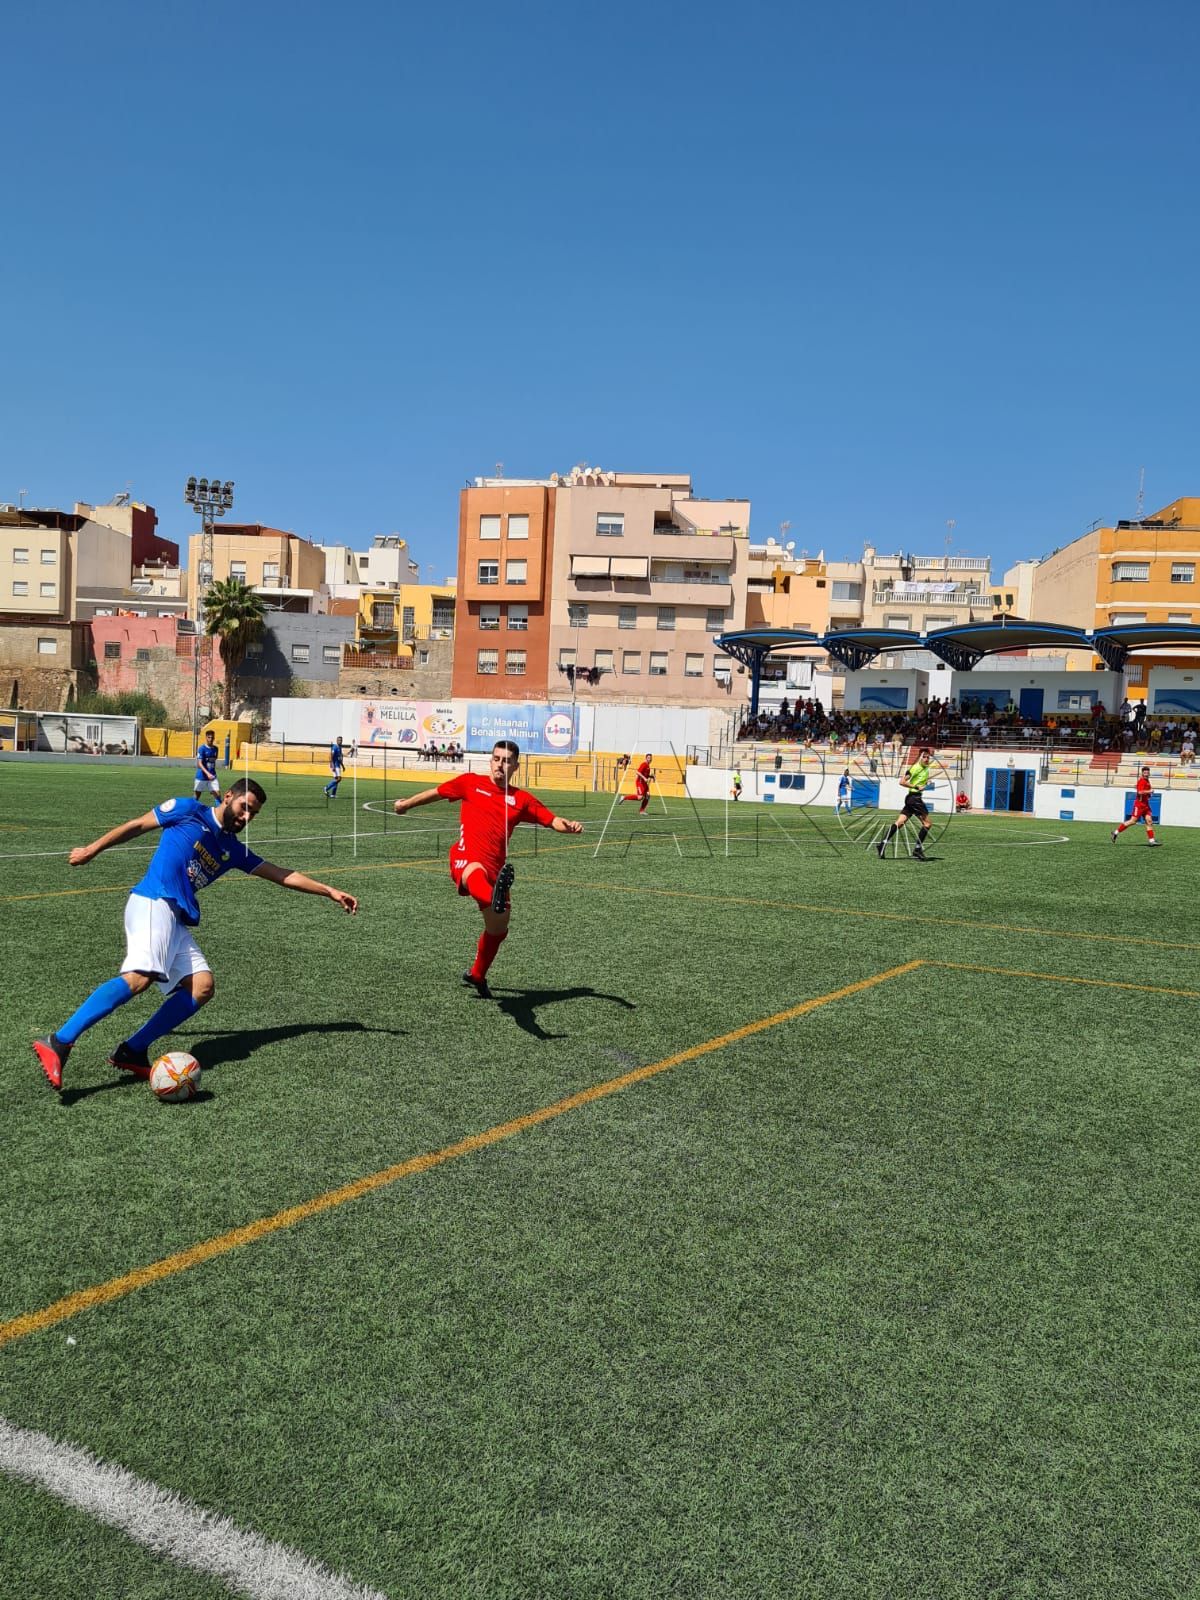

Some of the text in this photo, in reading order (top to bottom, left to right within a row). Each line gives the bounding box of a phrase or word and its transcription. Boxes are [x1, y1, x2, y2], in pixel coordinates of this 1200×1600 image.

[380, 710, 417, 721] MELILLA
[481, 717, 529, 728] C/ Maanan
[471, 727, 539, 738] Benaisa Mimun
